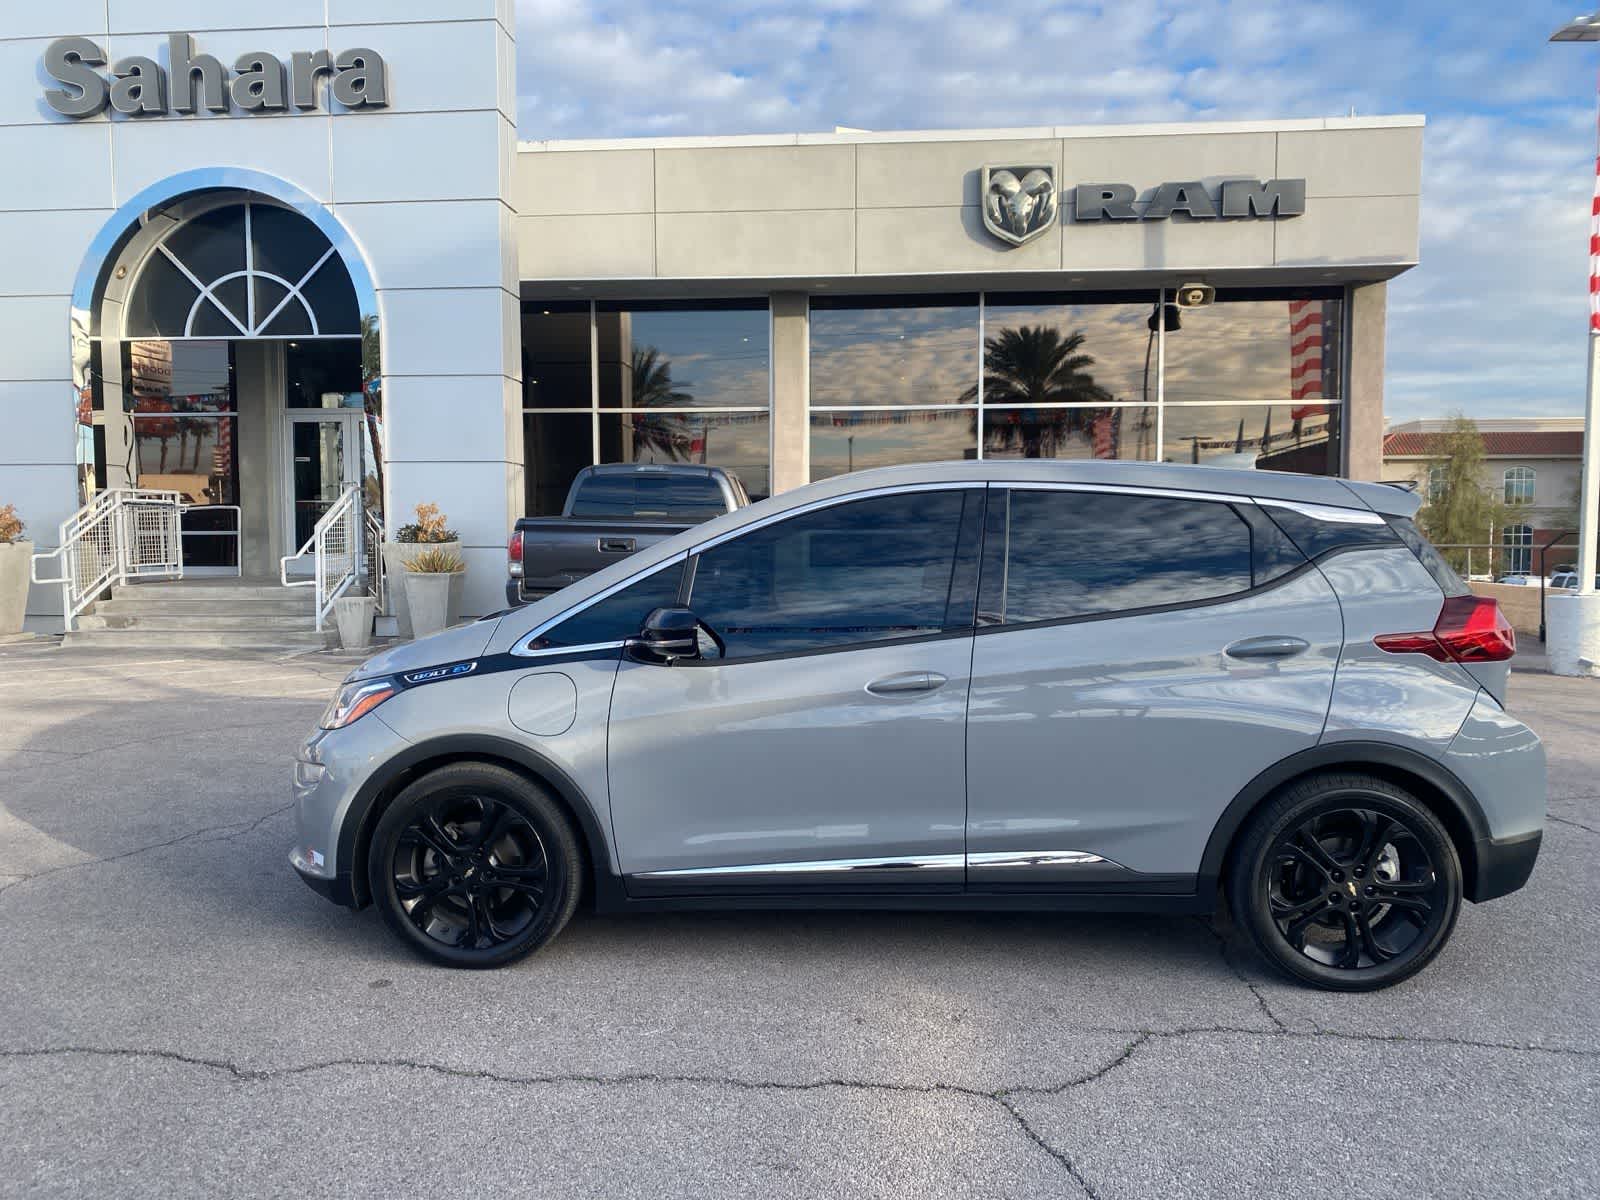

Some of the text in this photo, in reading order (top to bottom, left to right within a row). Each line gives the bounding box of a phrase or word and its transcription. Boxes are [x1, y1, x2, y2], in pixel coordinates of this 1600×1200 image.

[45, 32, 389, 118] Sahara
[1076, 178, 1306, 220] RAM
[413, 663, 472, 680] BOLT EV
